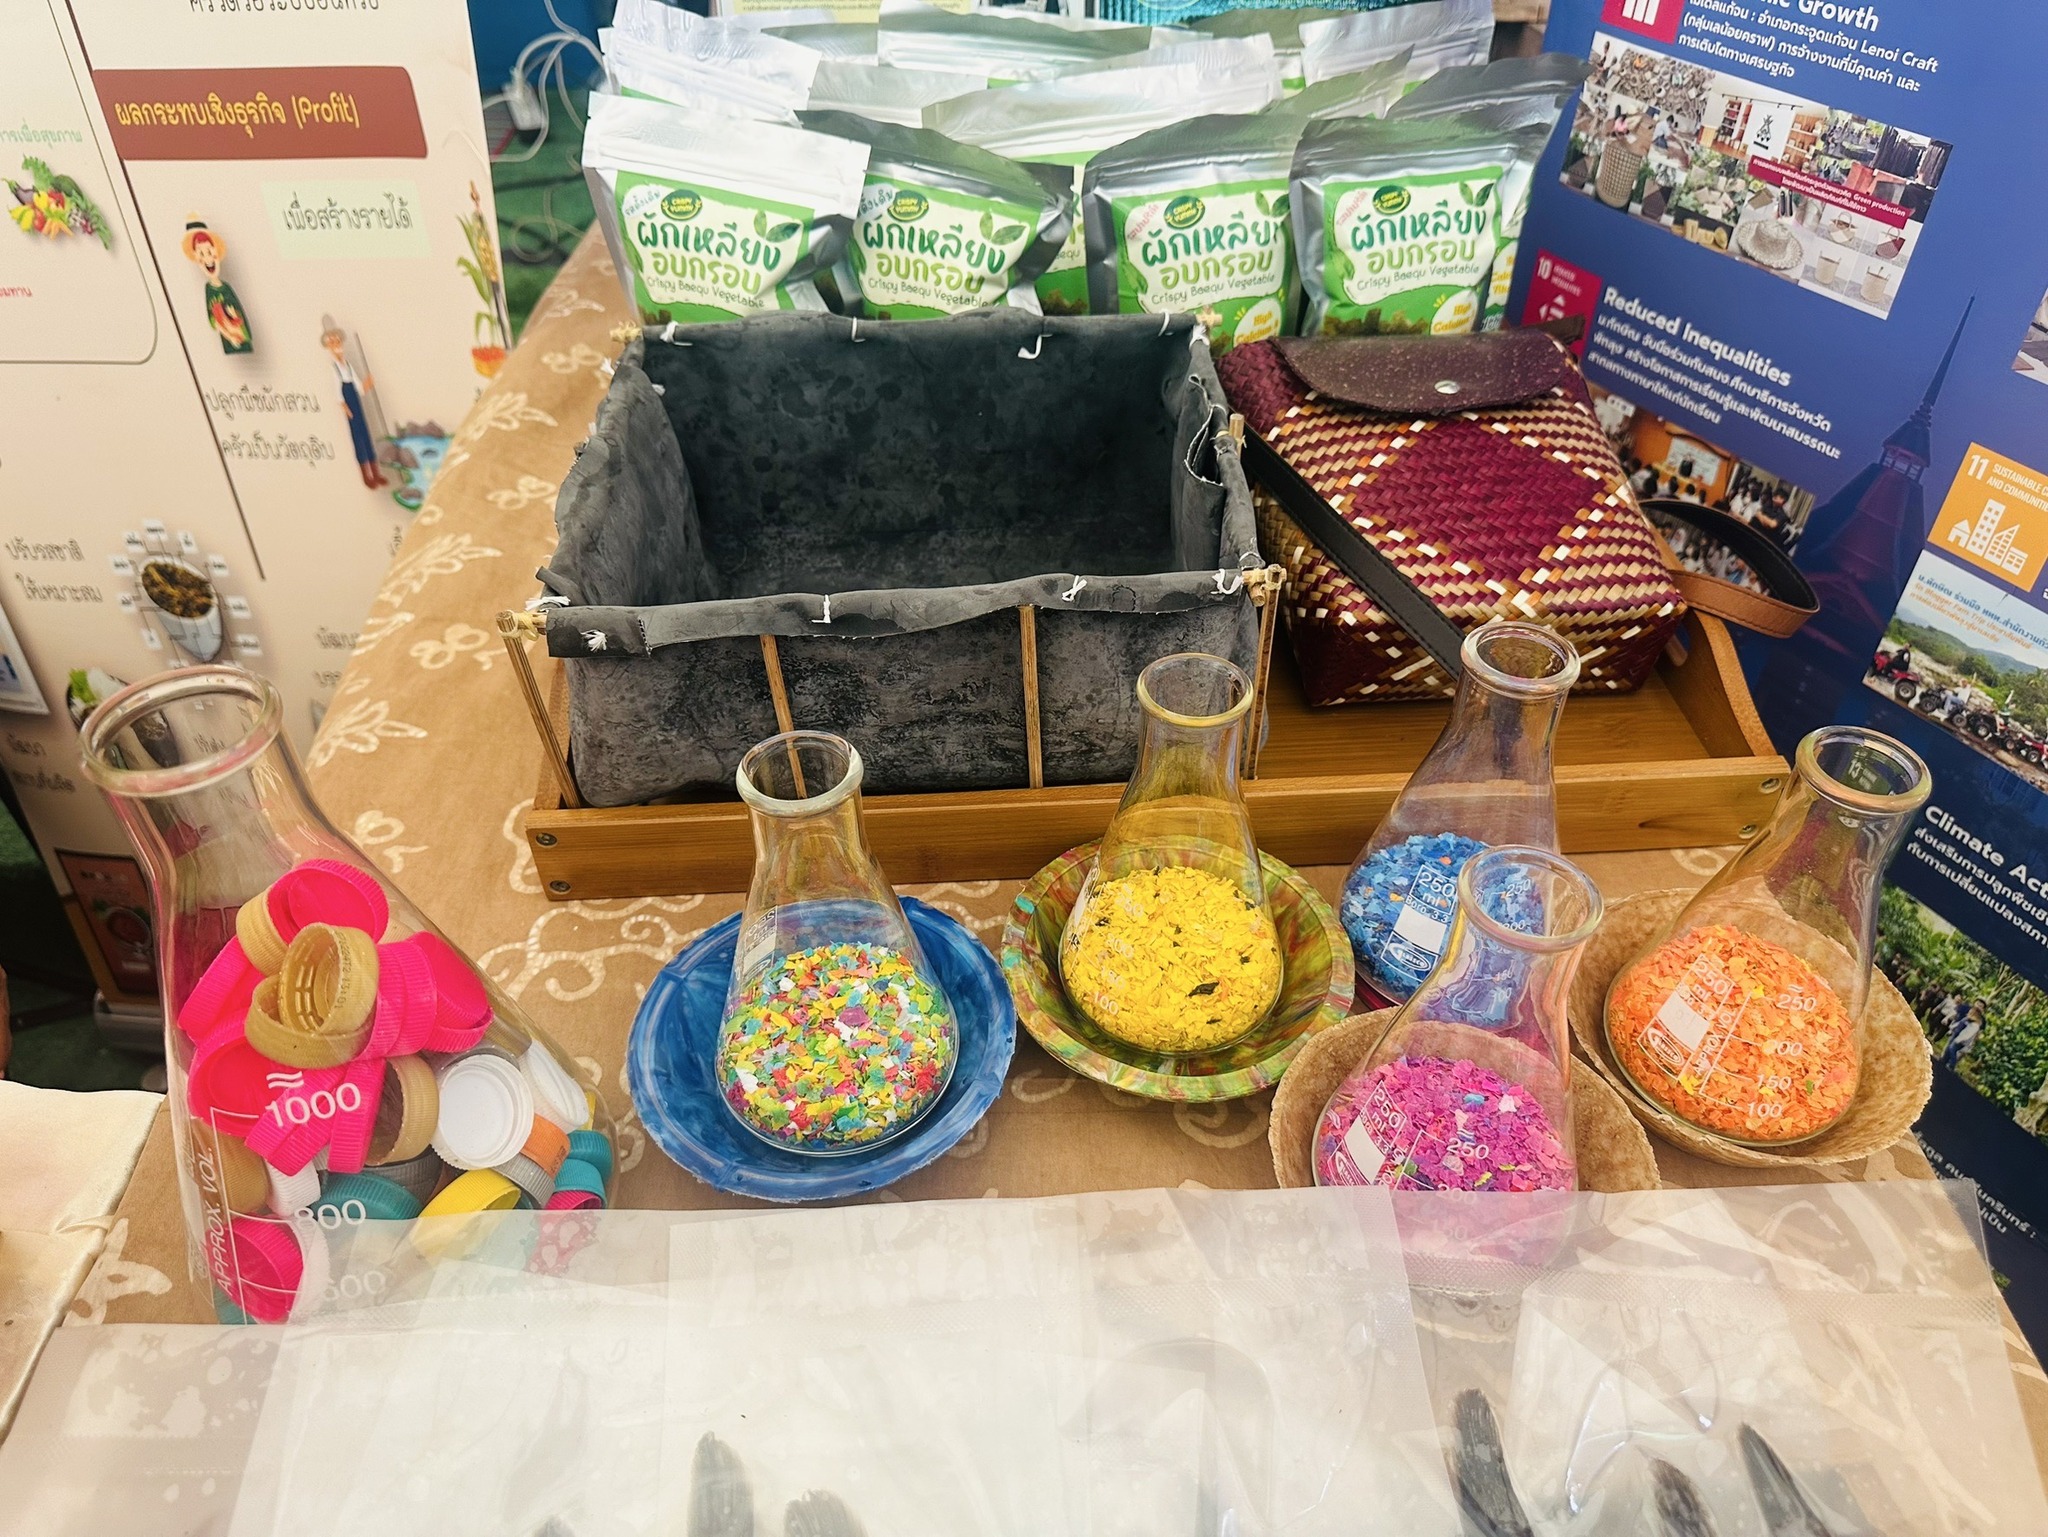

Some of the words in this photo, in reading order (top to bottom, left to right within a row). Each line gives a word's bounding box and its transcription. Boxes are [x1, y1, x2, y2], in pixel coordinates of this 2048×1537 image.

[1799, 0, 1879, 33] Growth
[1678, 34, 1795, 78] การเติบโตทางเศรษฐกิจ
[1683, 12, 1776, 53] (กลุ่มเลน้อยคราฟ)
[1778, 42, 1894, 86] การจ้างงานที่มีคุณค่า
[1896, 76, 1921, 92] และ
[1860, 39, 1899, 62] Lenoi
[1902, 51, 1939, 74] Craft
[114, 91, 287, 139] ผลกระทบเชิงธุรกิจ
[291, 91, 360, 129] (Profit)
[282, 190, 413, 231] เพื่อสร้างรายได้
[1853, 193, 1872, 206] Green
[1871, 200, 1906, 217] production
[1158, 249, 1273, 290] อบกรอบ
[1365, 239, 1476, 275] อบกรอบ
[1537, 255, 1552, 281] 10
[650, 252, 762, 296] อบกรอบ
[875, 253, 985, 295] อบกรอบ
[1151, 289, 1188, 306] Crispy
[1228, 273, 1276, 291] Vegetable
[1356, 274, 1392, 291] Crispy
[1429, 262, 1479, 278] Vegetable
[646, 275, 676, 292] Crispy
[713, 287, 765, 309] Vegetable
[867, 278, 898, 295] Crispy
[933, 288, 989, 308] Vegetable
[1603, 286, 1682, 336] Reduced
[1682, 322, 1791, 387] Inequalities
[1967, 454, 1989, 481] 11
[1992, 463, 2042, 493] SUSTAINABLE
[1986, 476, 2004, 490] AND
[1925, 805, 2005, 867] Climate
[2008, 863, 2048, 901] Act
[1418, 871, 1455, 899] 250
[1422, 892, 1440, 907] ml
[1507, 878, 1531, 897] 250
[1906, 841, 2048, 949] กับการเปลี่ยนแปลงสภา
[1405, 895, 1428, 914] Boro
[1430, 909, 1450, 923] 3.3
[1695, 962, 1728, 995] 250
[1094, 991, 1119, 1016] 100
[1776, 993, 1817, 1012] 250
[1757, 1074, 1792, 1090] 150
[265, 1082, 361, 1128] 1000
[1373, 1088, 1400, 1129] 250
[1748, 1102, 1783, 1118] 100
[1446, 1137, 1490, 1160] 250
[199, 1147, 215, 1194] VOL.
[294, 1199, 367, 1231] 800
[206, 1201, 233, 1297] APPROX.
[325, 1270, 386, 1302] 600
